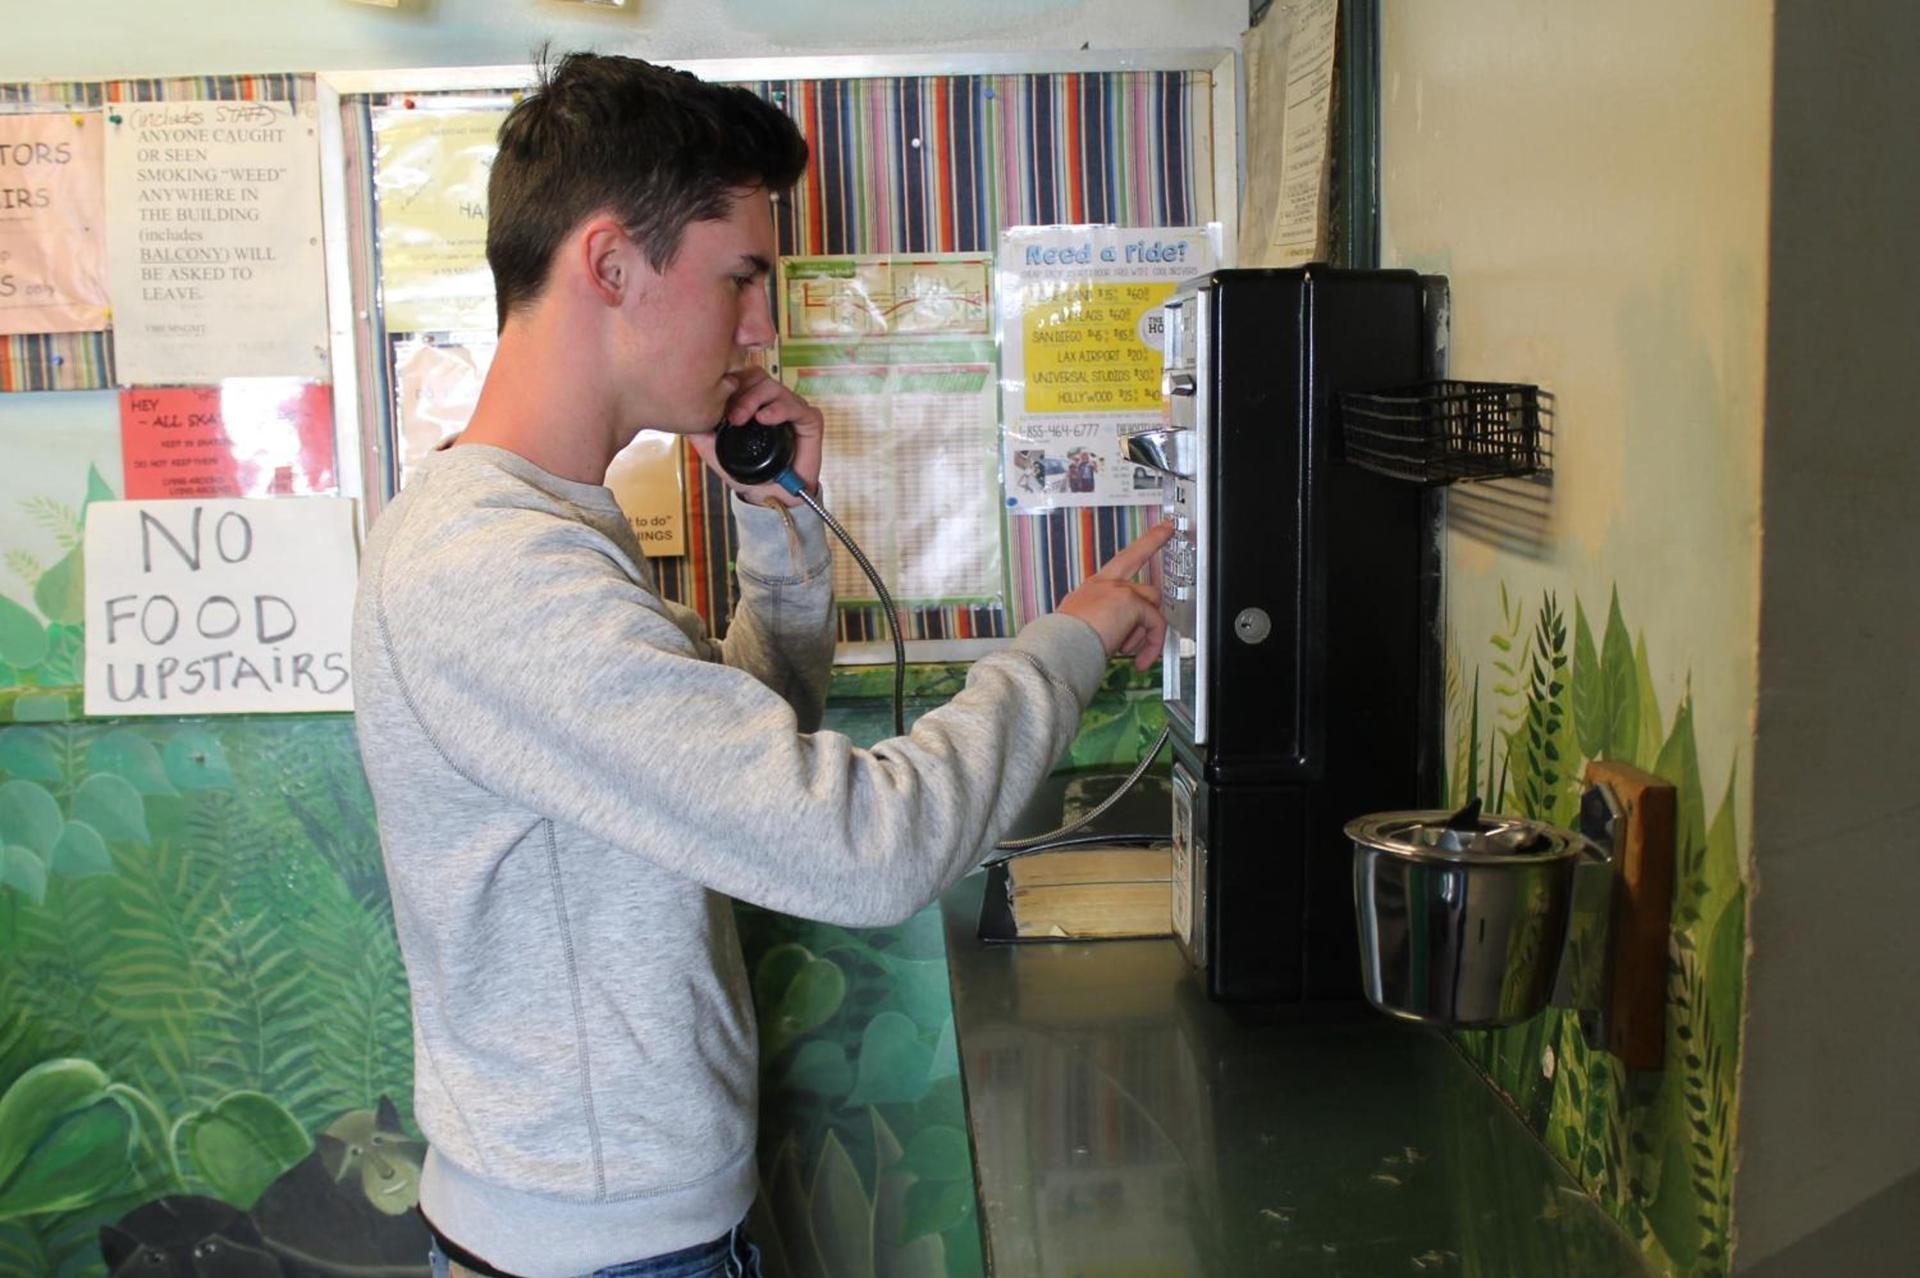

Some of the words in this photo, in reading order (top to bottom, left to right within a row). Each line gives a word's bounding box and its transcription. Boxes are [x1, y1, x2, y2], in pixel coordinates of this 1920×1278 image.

[138, 129, 209, 143] ANYONE
[213, 127, 285, 143] CAUGHT
[137, 149, 162, 163] OR
[164, 149, 207, 163] SEEN
[137, 168, 218, 183] SMOKING
[0, 187, 50, 209] IRS
[138, 188, 236, 202] ANYWHERE
[241, 187, 258, 201] IN
[139, 208, 171, 222] THE
[177, 207, 259, 222] BUILDING
[459, 201, 489, 219] HA
[139, 228, 203, 242] (includes
[140, 247, 231, 262] BALCONY)
[234, 247, 276, 261] WILL
[1026, 243, 1091, 266] Need
[1100, 246, 1116, 262] a
[1125, 239, 1189, 264] ride?
[141, 267, 163, 281] BE
[168, 266, 225, 281] ASKED
[230, 266, 252, 281] TO
[142, 287, 203, 301] LEAVE.
[1077, 349, 1120, 363] AIRPORT
[1032, 370, 1089, 385] UNIVERSAL
[131, 400, 159, 411] HEY
[152, 415, 181, 428] ALL
[635, 516, 648, 527] to
[139, 506, 253, 573] NO
[105, 594, 297, 646] FOOD
